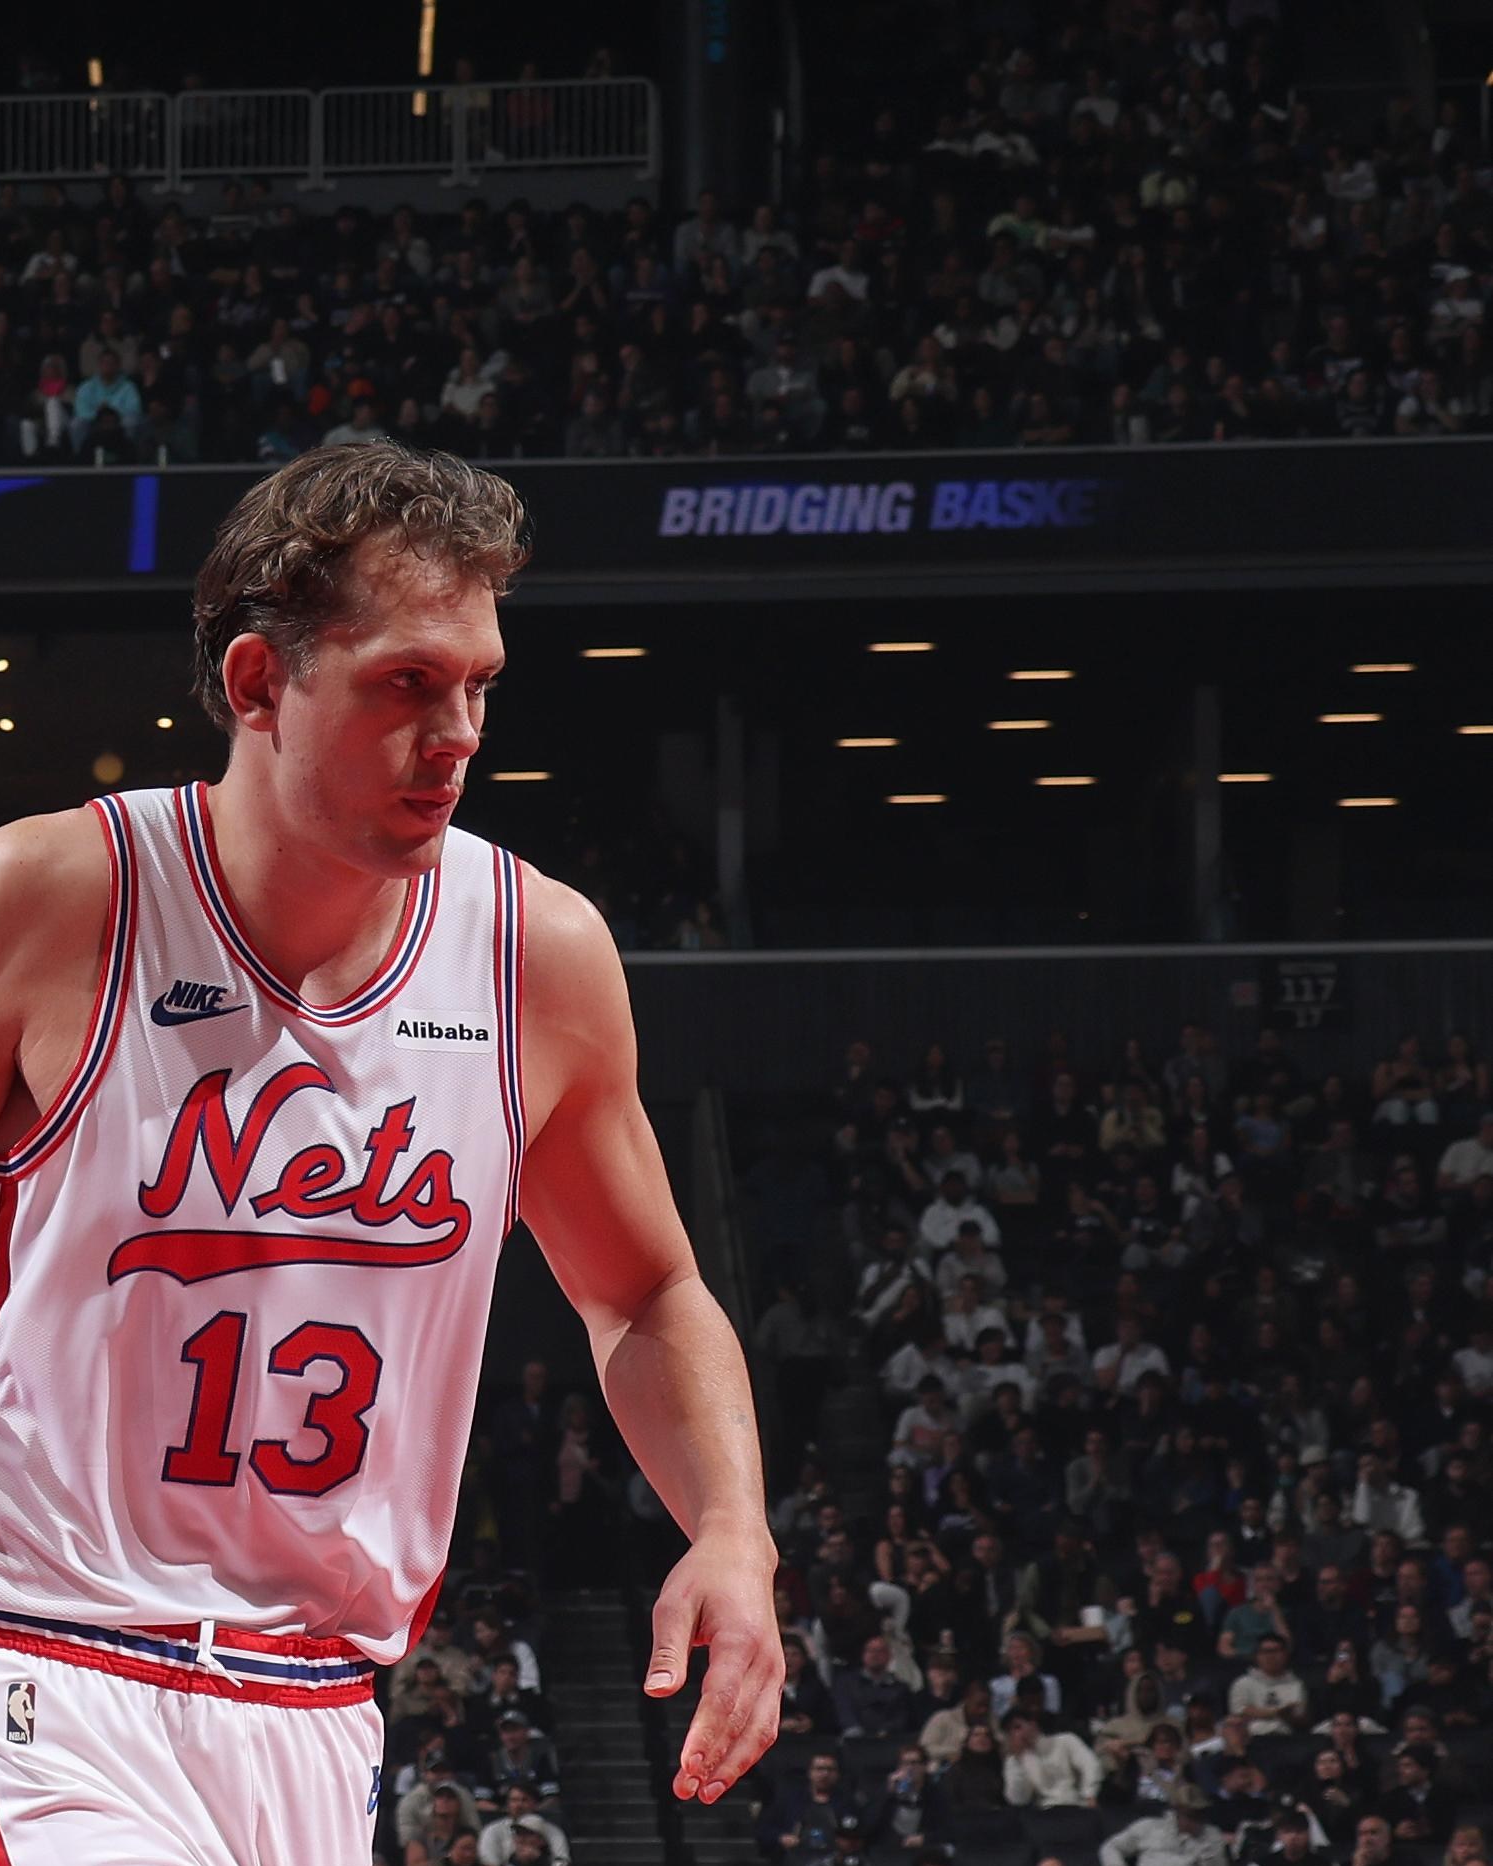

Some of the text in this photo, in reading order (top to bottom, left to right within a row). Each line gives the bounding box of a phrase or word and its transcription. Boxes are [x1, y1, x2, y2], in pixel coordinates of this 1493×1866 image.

[659, 482, 915, 537] BRIDGING
[165, 979, 228, 1012] NIKE
[1281, 977, 1336, 1002] 117
[396, 1019, 489, 1041] Alibaba
[132, 1061, 472, 1236] Nets
[161, 1310, 383, 1498] 13
